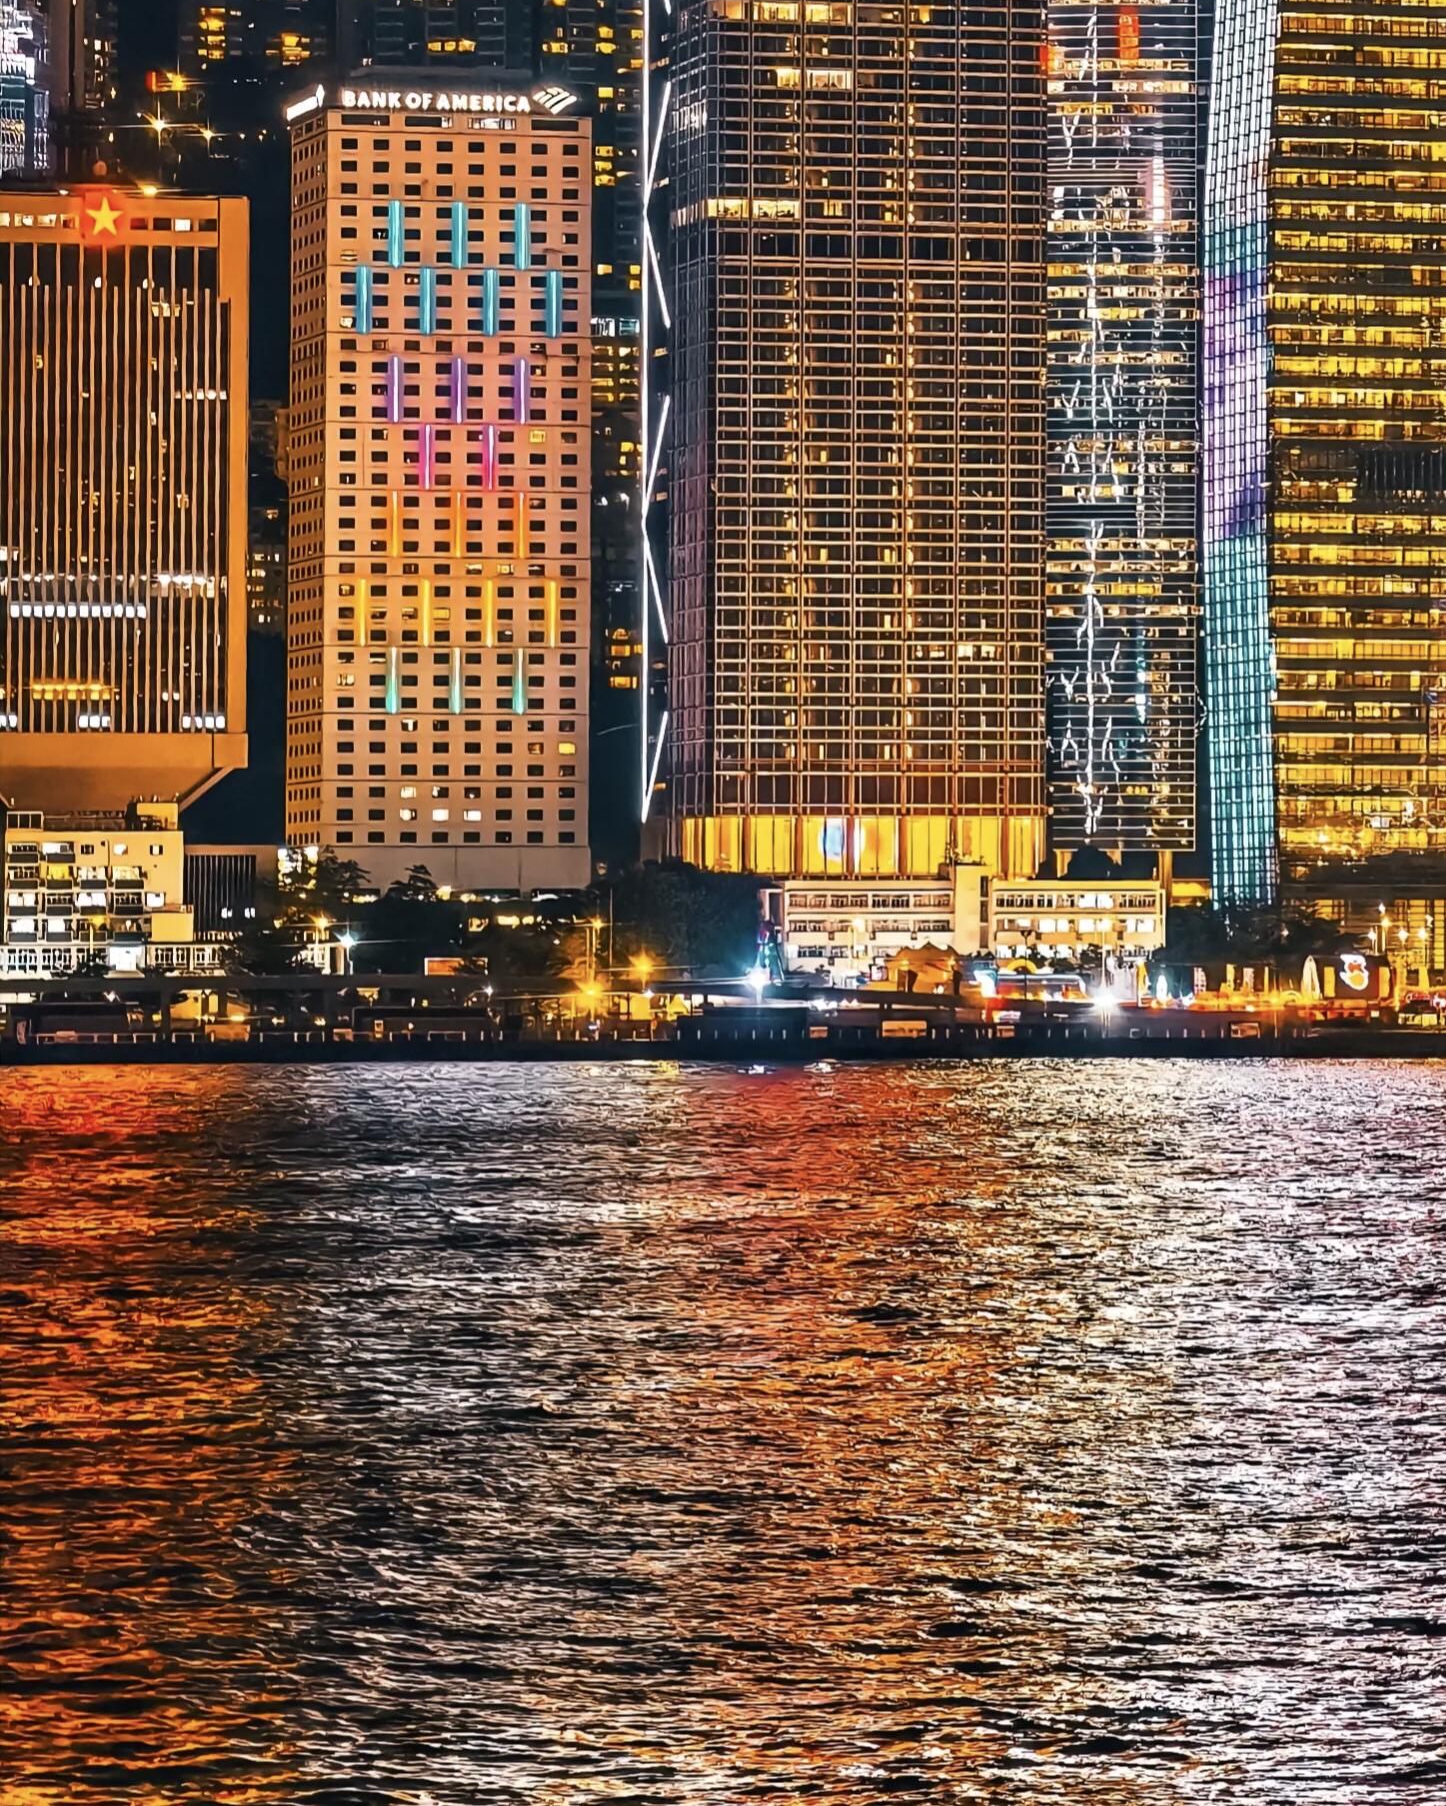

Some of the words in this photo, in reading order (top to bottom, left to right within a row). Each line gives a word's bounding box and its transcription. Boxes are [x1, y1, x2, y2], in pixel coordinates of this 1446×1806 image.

[341, 89, 402, 109] BANK
[405, 92, 433, 110] OF
[436, 92, 532, 113] AMERICA
